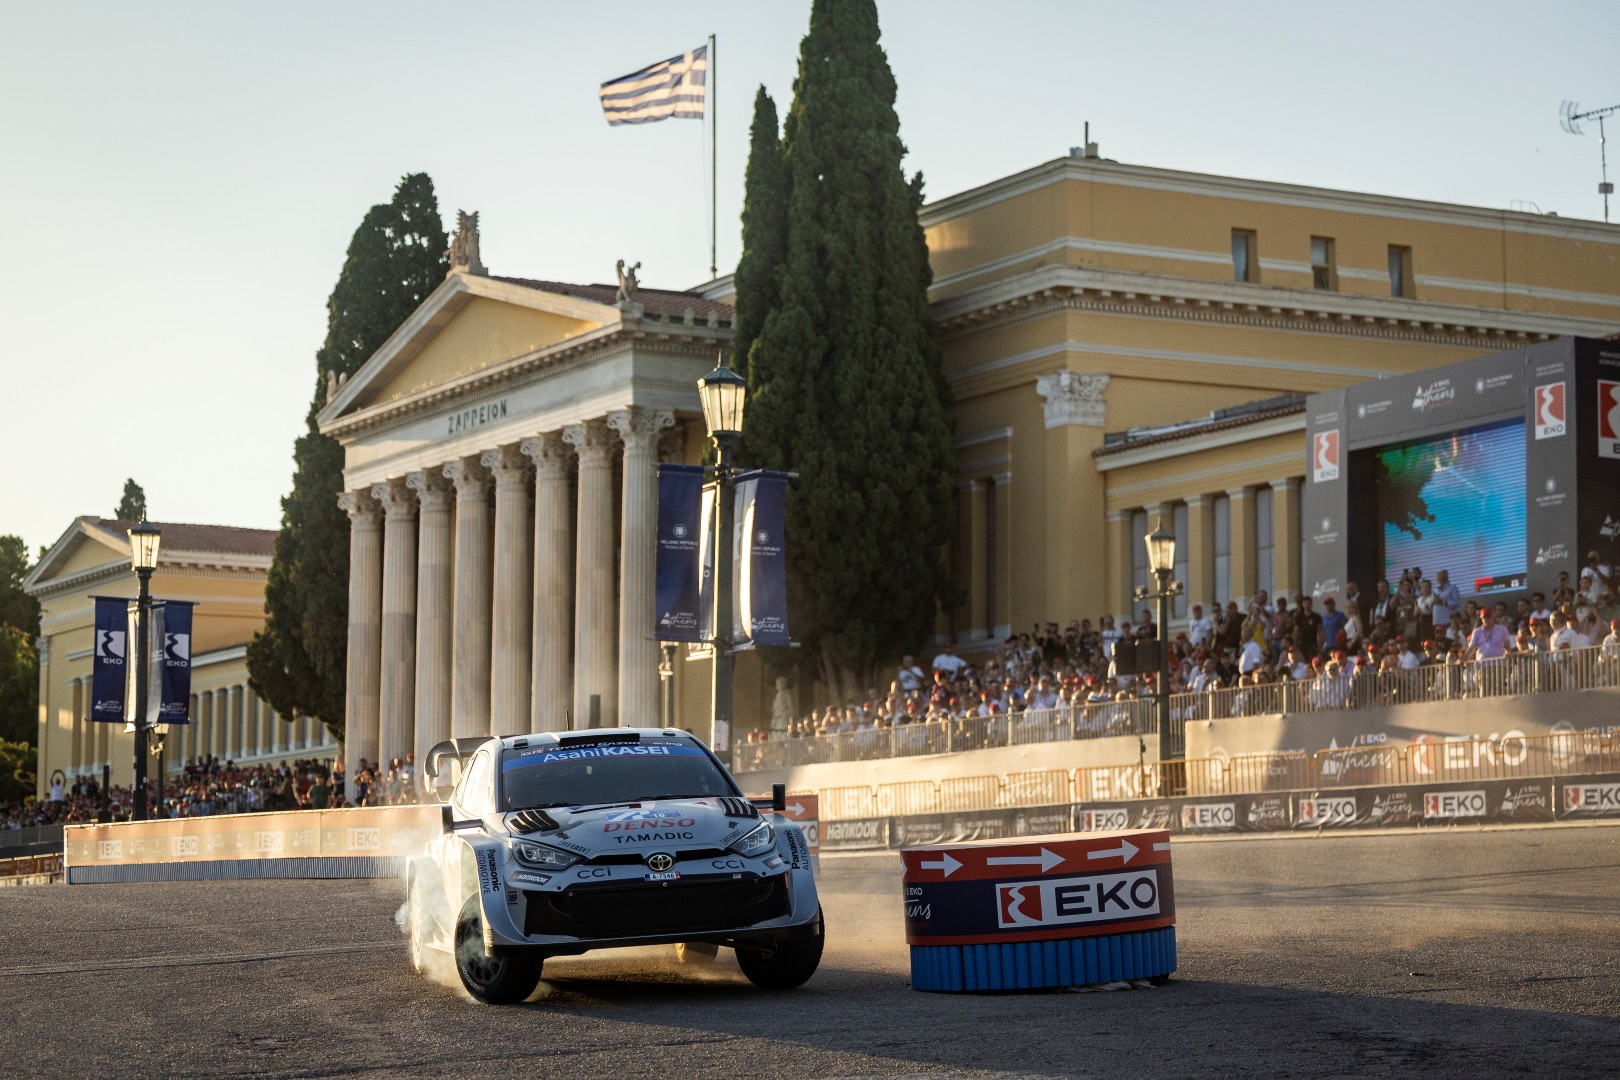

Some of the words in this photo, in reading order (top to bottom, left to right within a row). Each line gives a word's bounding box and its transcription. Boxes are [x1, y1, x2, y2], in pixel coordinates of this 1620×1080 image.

[1544, 424, 1564, 435] EKO
[103, 657, 123, 665] EKO
[166, 660, 188, 668] EKO
[1367, 732, 1387, 744] EKO
[1444, 729, 1528, 770] EKO
[1317, 801, 1355, 818] EKO
[1443, 793, 1484, 812] EKO
[1094, 812, 1127, 828] EKO
[1199, 806, 1235, 823] EKO
[603, 818, 696, 833] DENSO
[614, 832, 694, 844] TAMADIC
[784, 829, 801, 870] Panasonic
[486, 848, 502, 892] Panasonic
[1054, 876, 1157, 917] EKO
